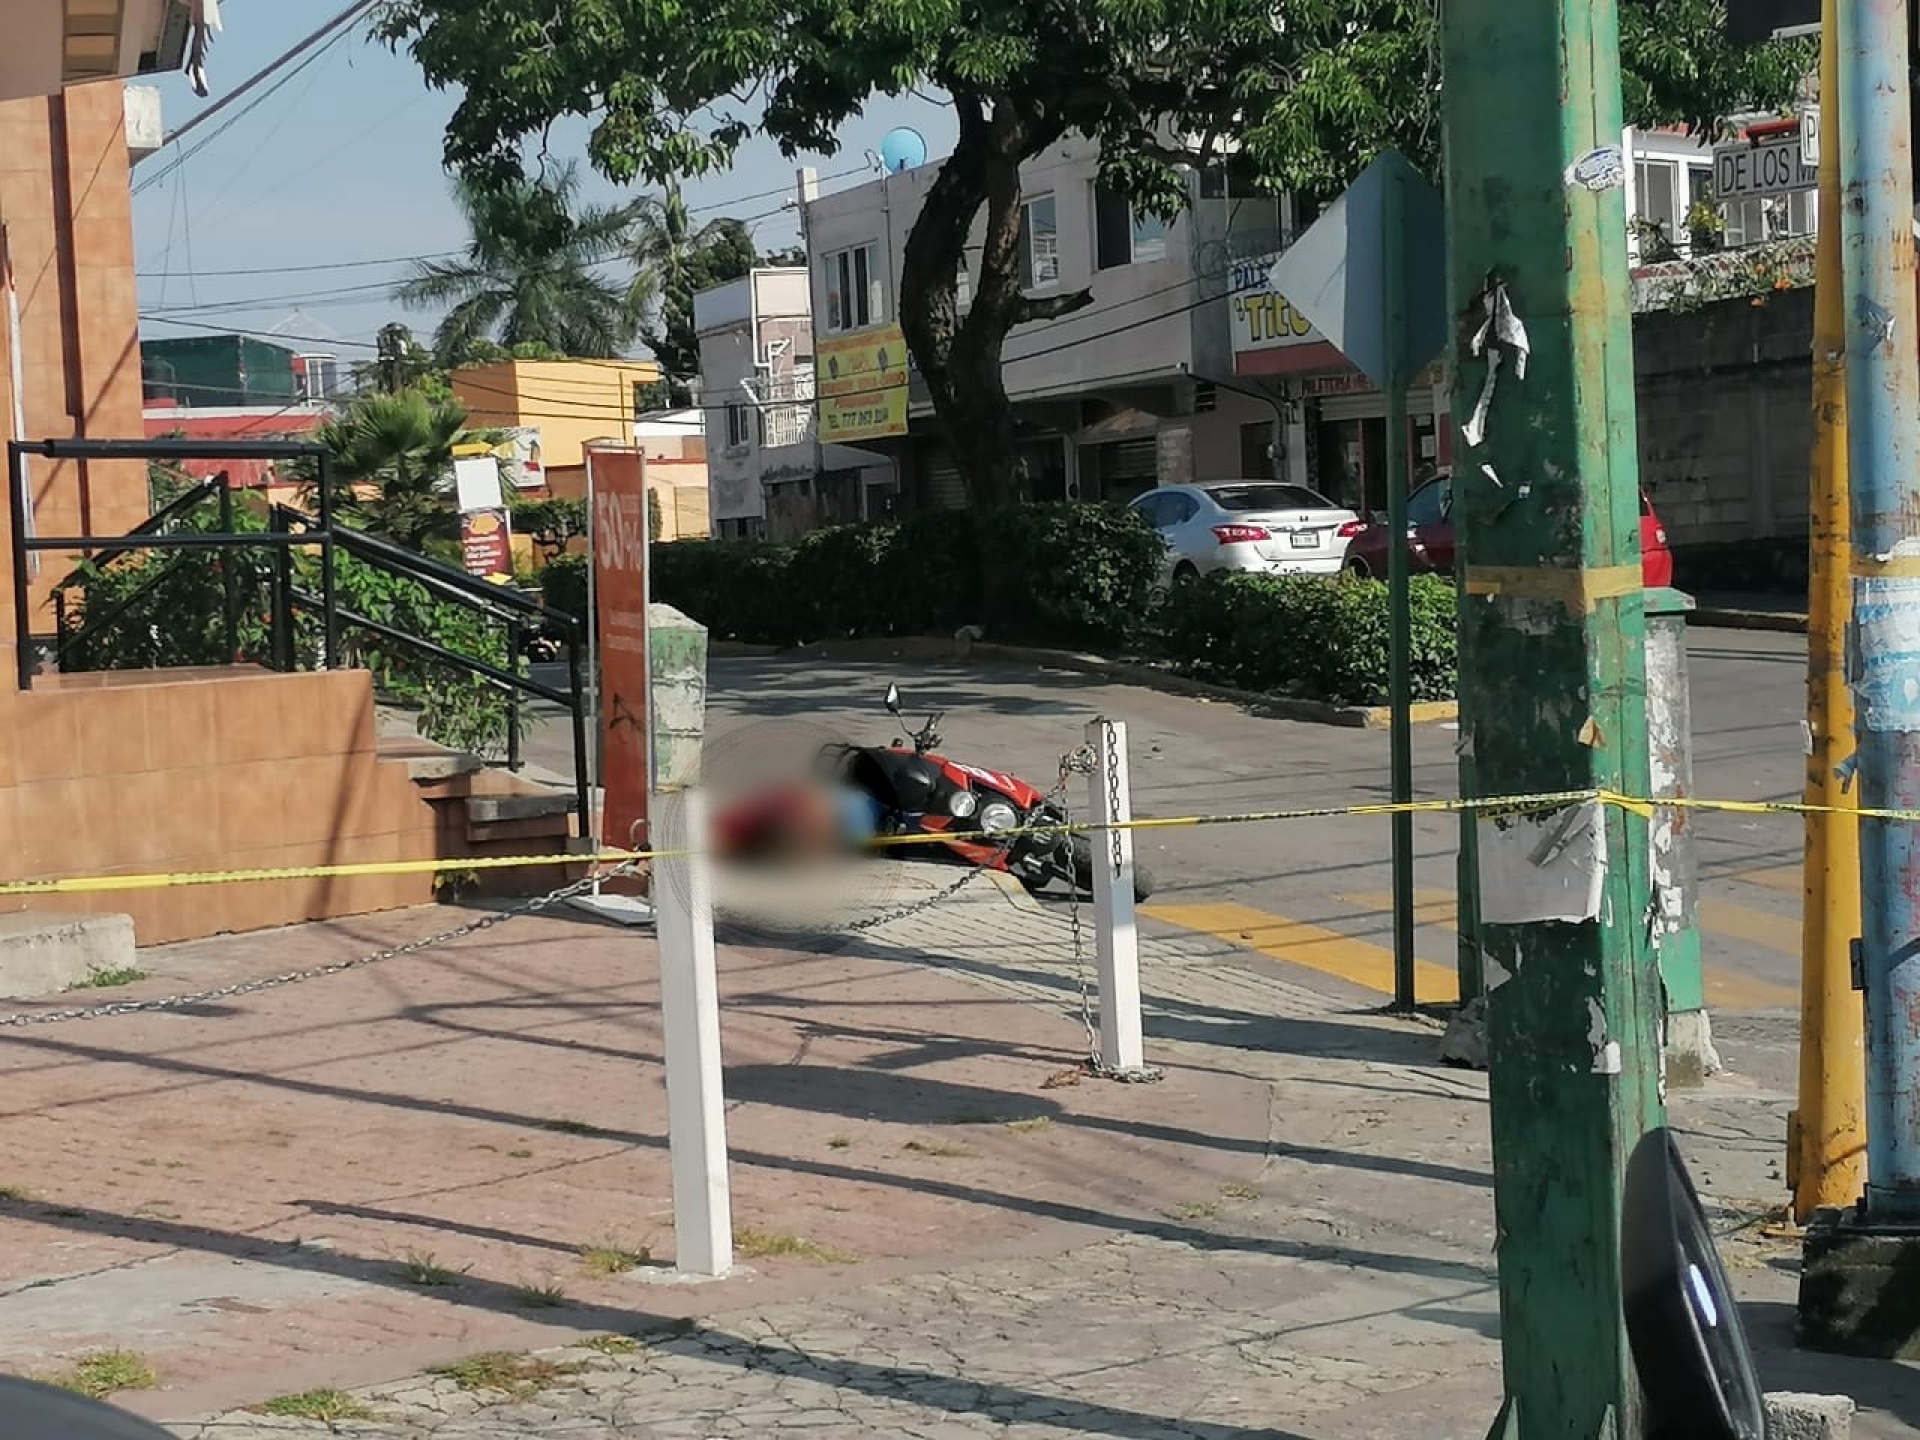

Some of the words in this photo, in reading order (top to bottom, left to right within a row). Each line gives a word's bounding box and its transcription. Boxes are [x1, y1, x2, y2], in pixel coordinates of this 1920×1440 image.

[1806, 114, 1818, 154] P
[1722, 154, 1747, 193] DE
[1752, 148, 1790, 188] LOS
[1796, 147, 1817, 184] M
[1235, 265, 1271, 290] PALE
[596, 491, 643, 572] 50%
